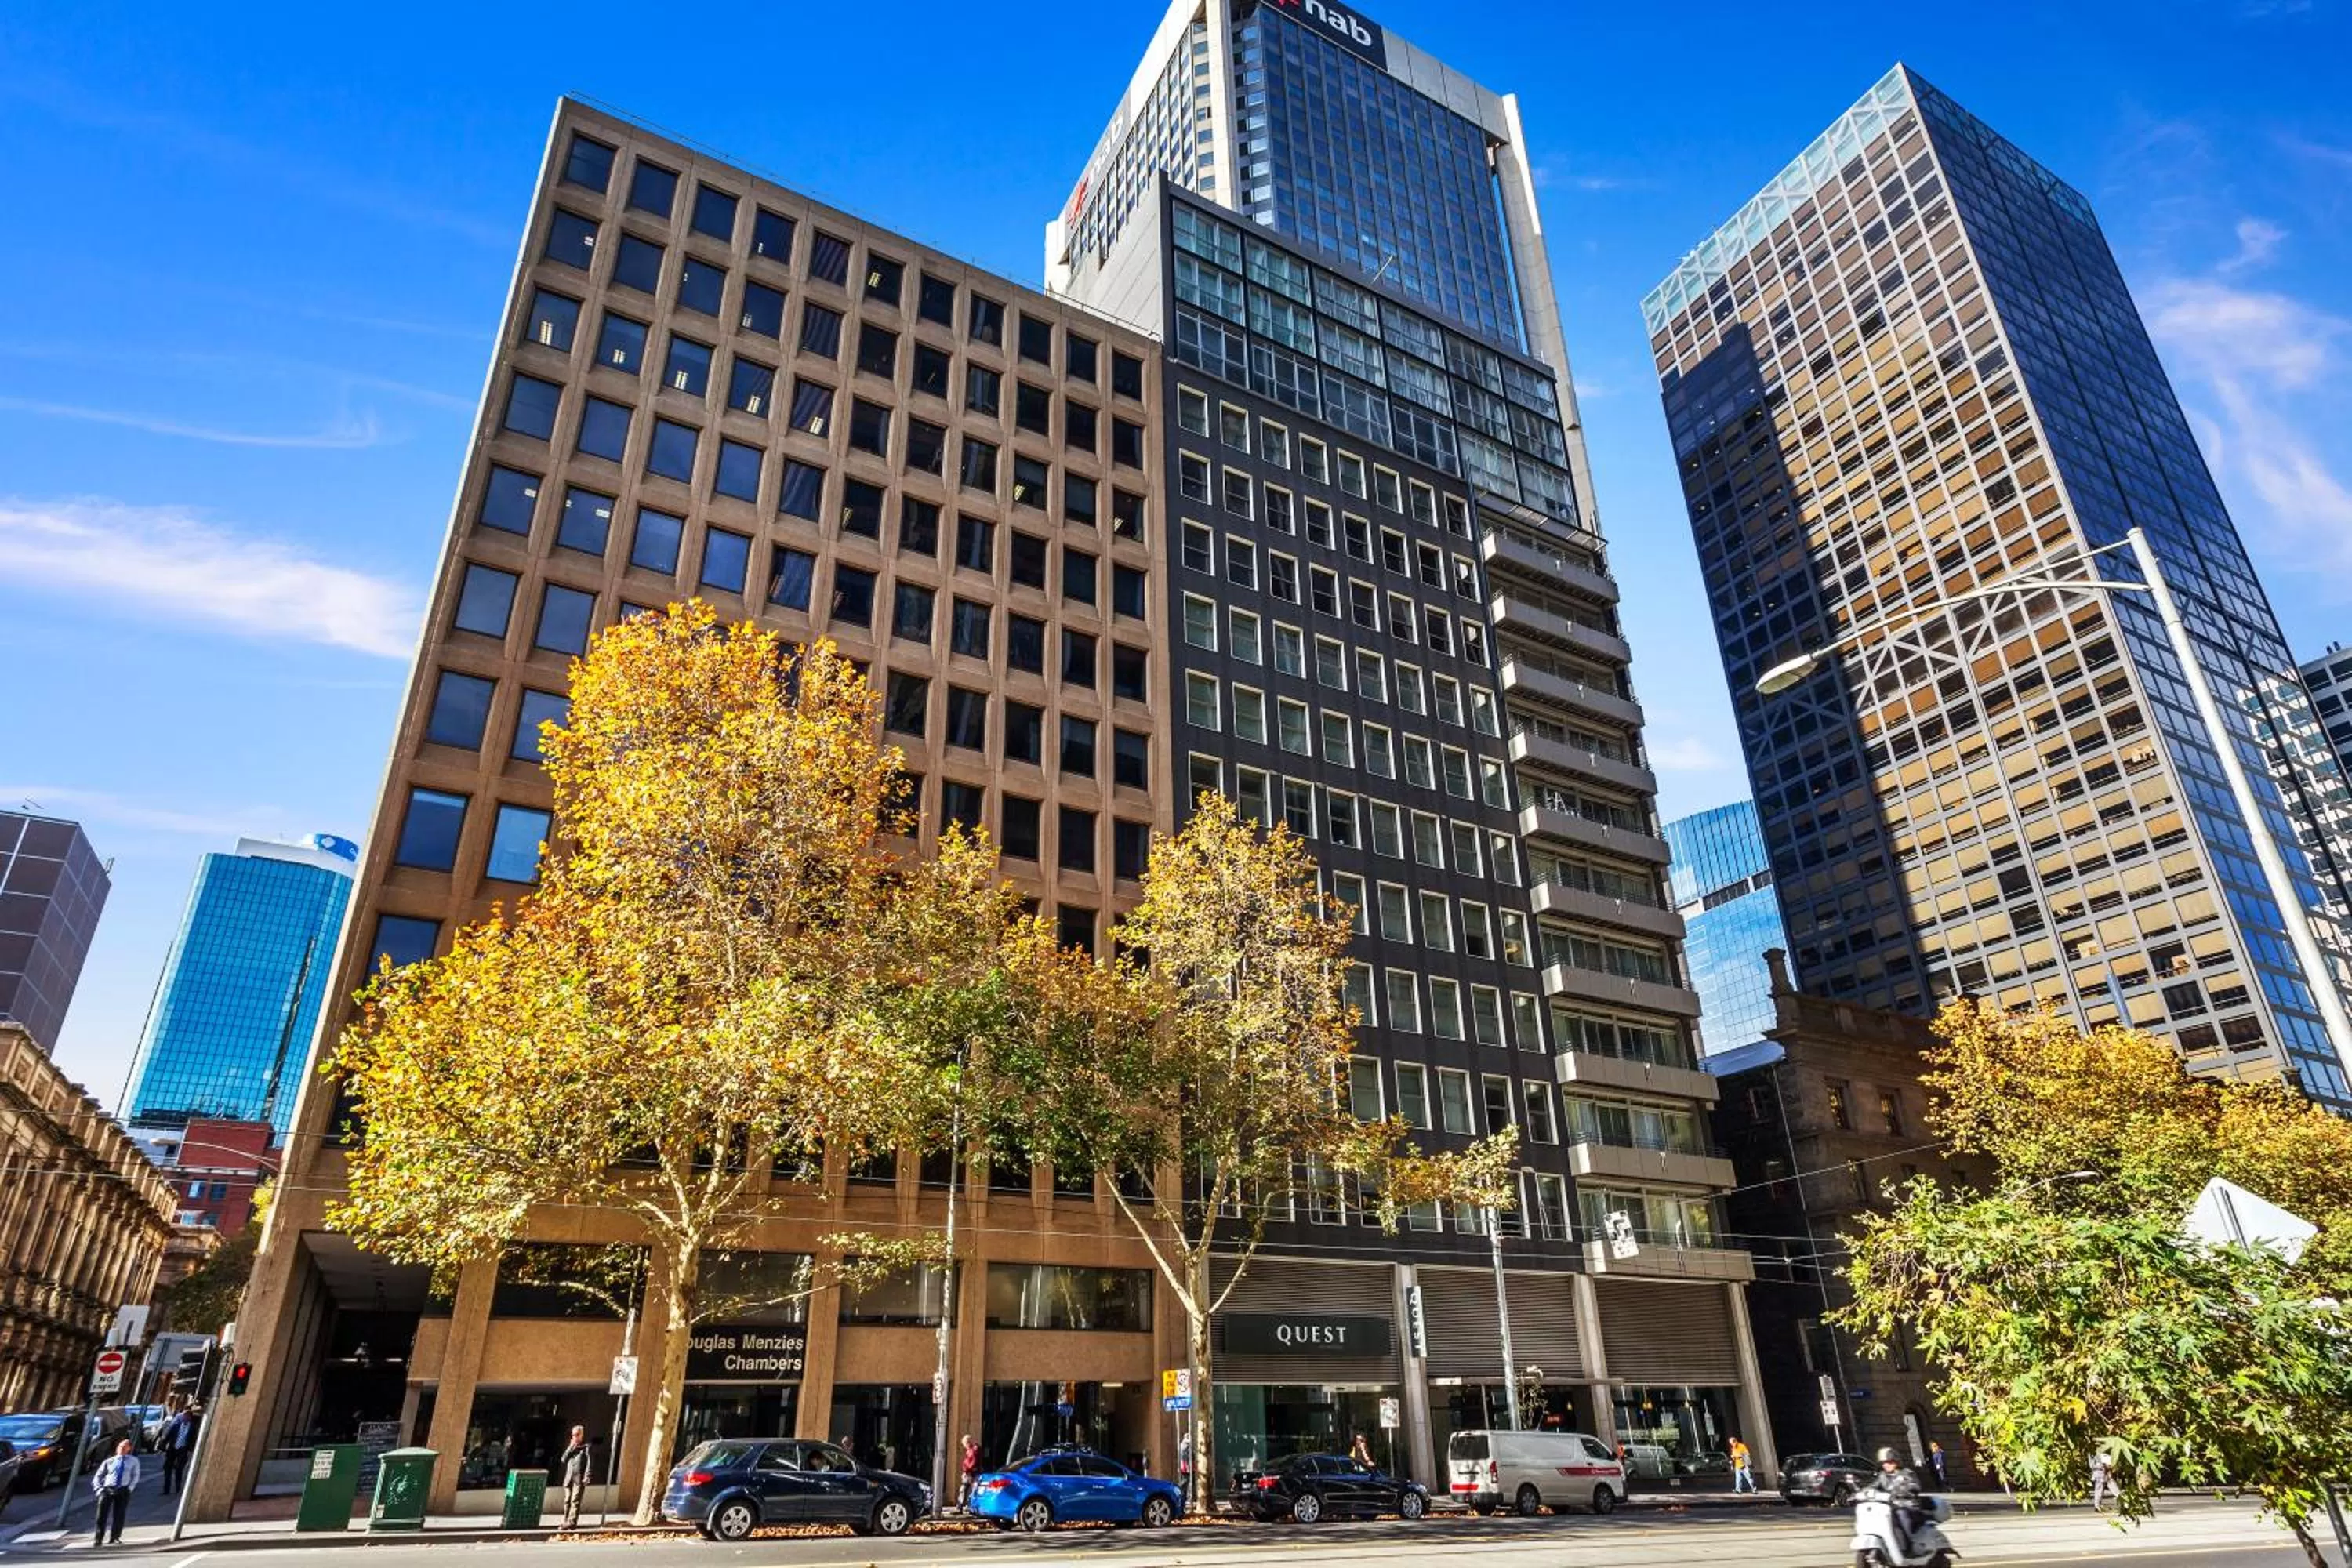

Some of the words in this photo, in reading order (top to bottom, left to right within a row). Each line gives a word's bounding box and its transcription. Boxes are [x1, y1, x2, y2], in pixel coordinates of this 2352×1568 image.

[1305, 0, 1372, 46] nab
[1409, 1292, 1421, 1349] QUEST
[688, 1334, 736, 1353] ouglas
[742, 1334, 804, 1351] Menzies
[1276, 1324, 1347, 1346] QUEST
[724, 1354, 803, 1370] Chambers
